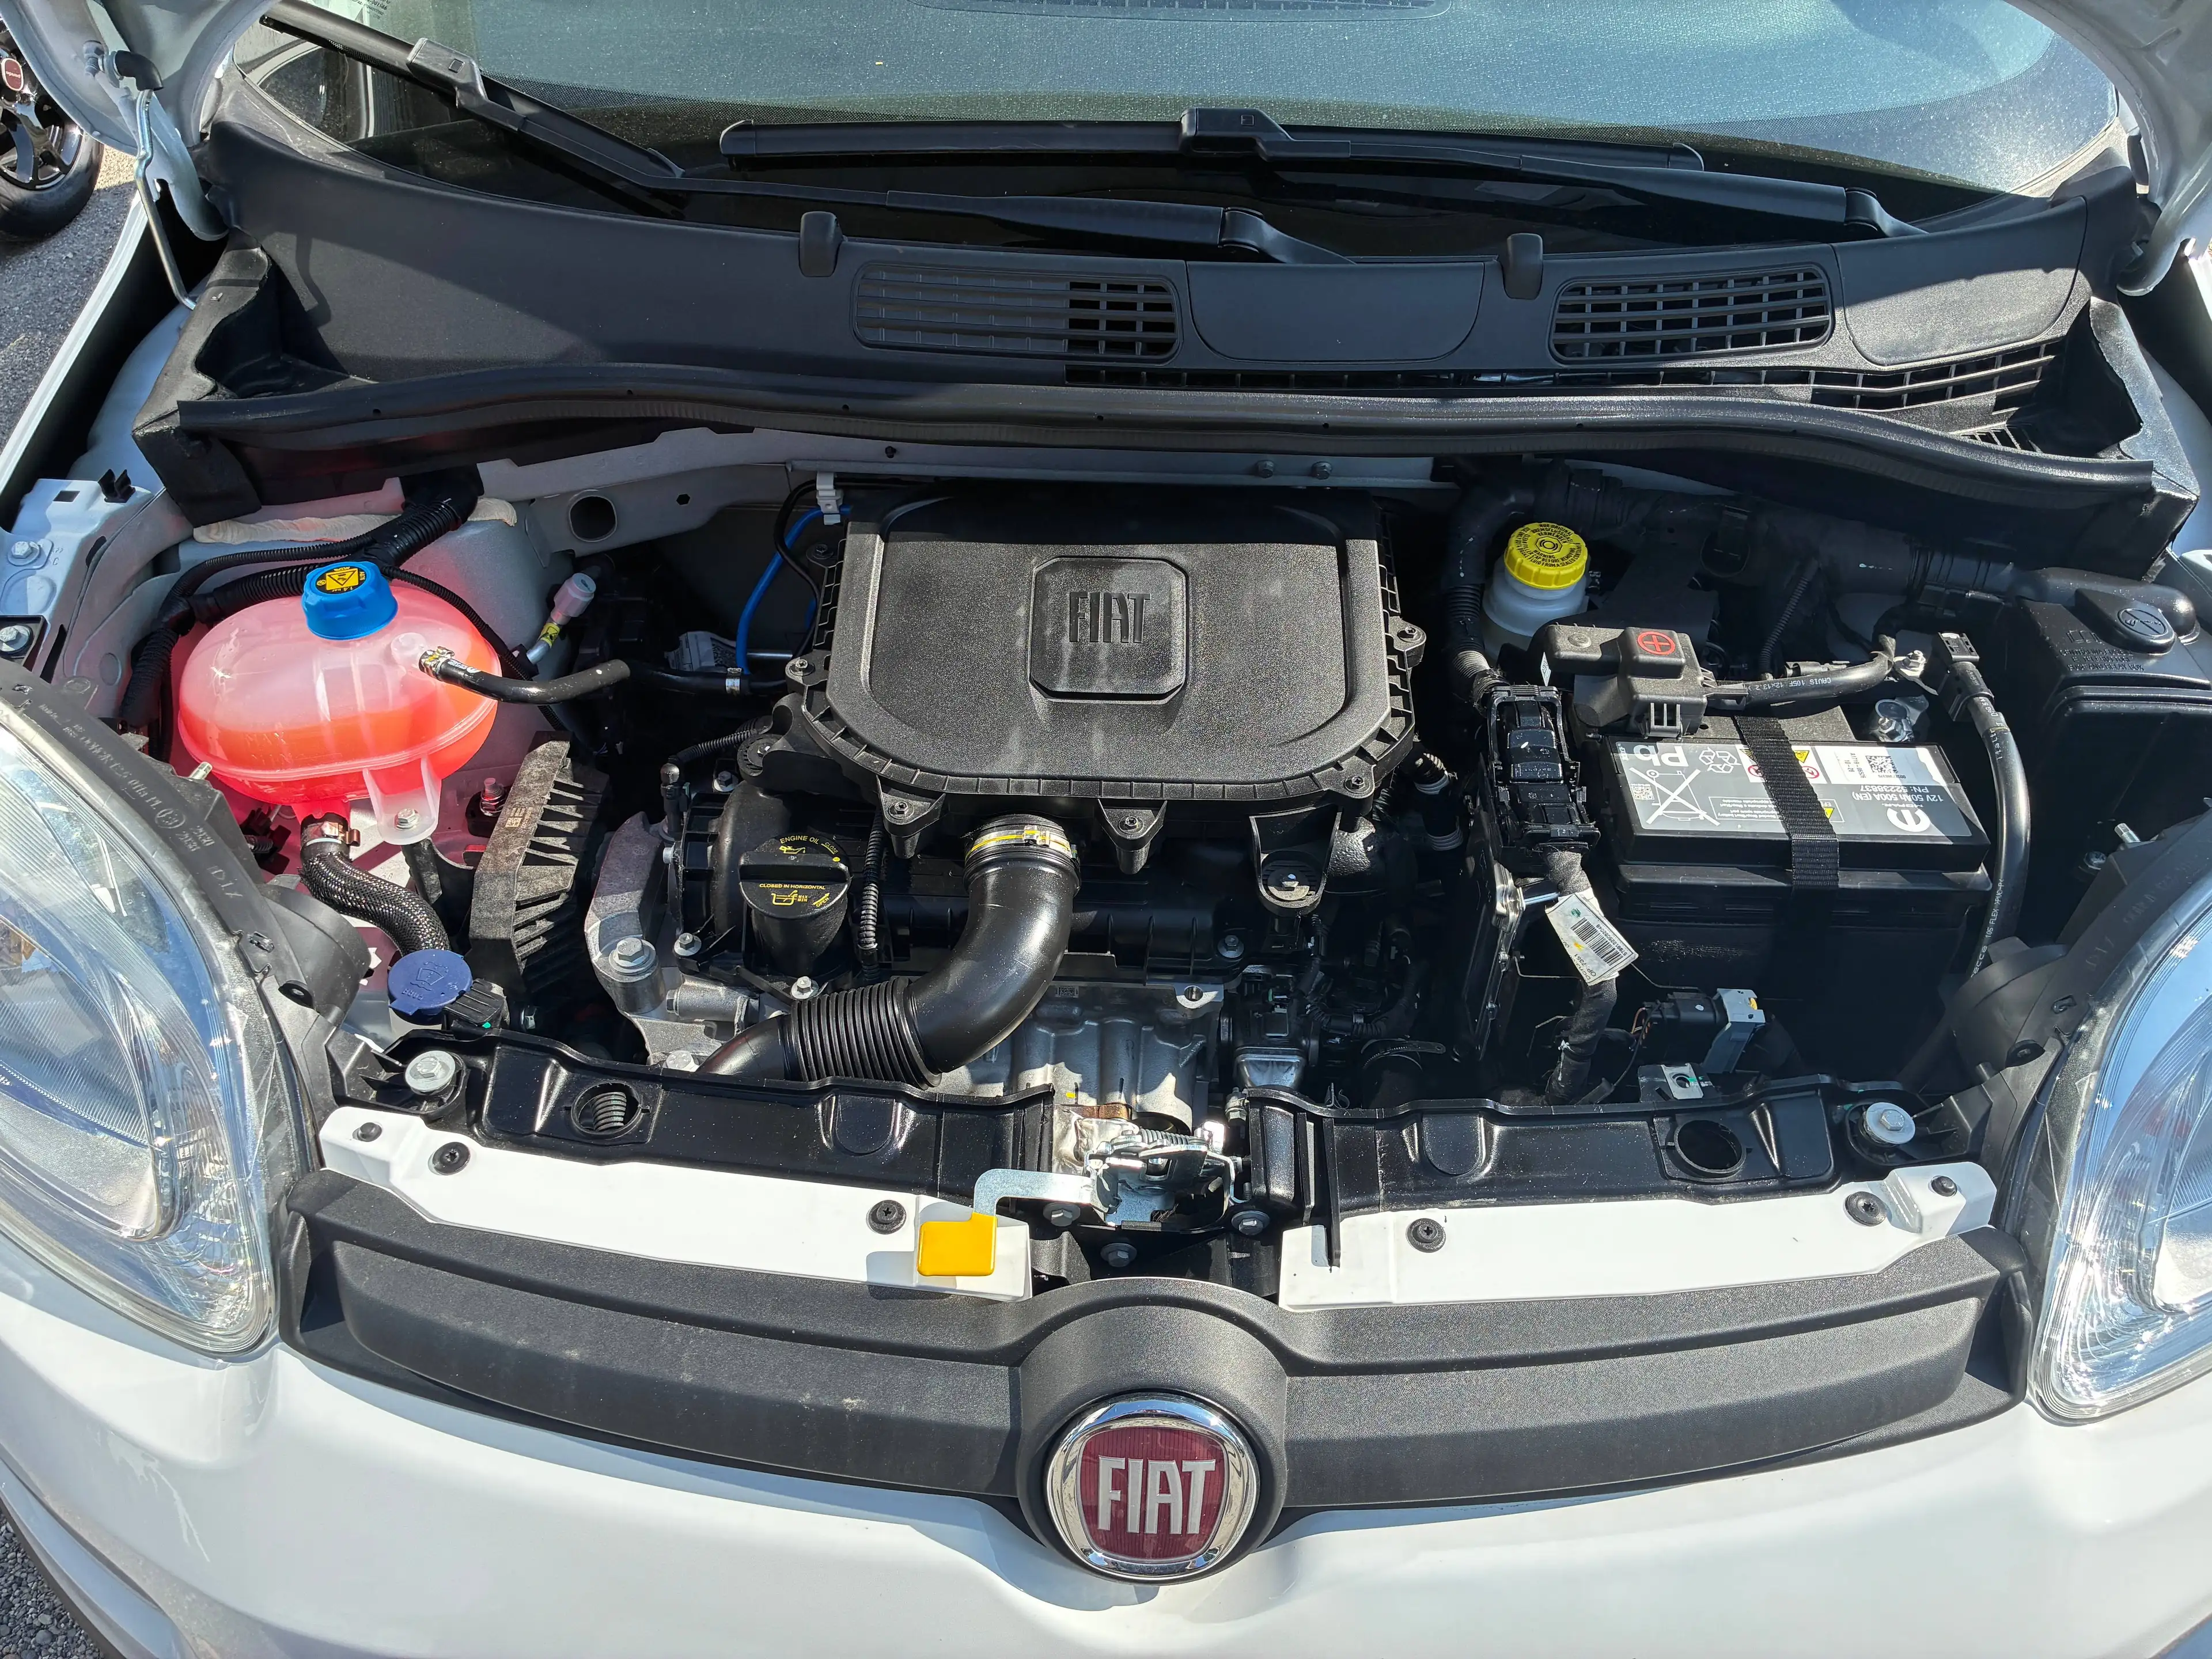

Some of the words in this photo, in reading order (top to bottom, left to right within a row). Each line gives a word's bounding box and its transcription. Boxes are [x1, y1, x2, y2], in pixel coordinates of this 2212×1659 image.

[1069, 590, 1150, 644] FIAT
[1809, 677, 1831, 685] CAVIS
[1633, 744, 1689, 767] Pb
[1852, 791, 1872, 801] (EN)
[1873, 793, 1899, 801] 500A
[1900, 793, 1924, 801] 50Ah
[1927, 794, 1944, 802] 12V
[779, 835, 808, 844] ENGINE
[809, 836, 820, 844] OIL
[824, 842, 839, 854] CLOSE
[816, 897, 830, 907] OPEN
[1989, 908, 1999, 925] FLEX
[1097, 1455, 1216, 1536] FIAT
